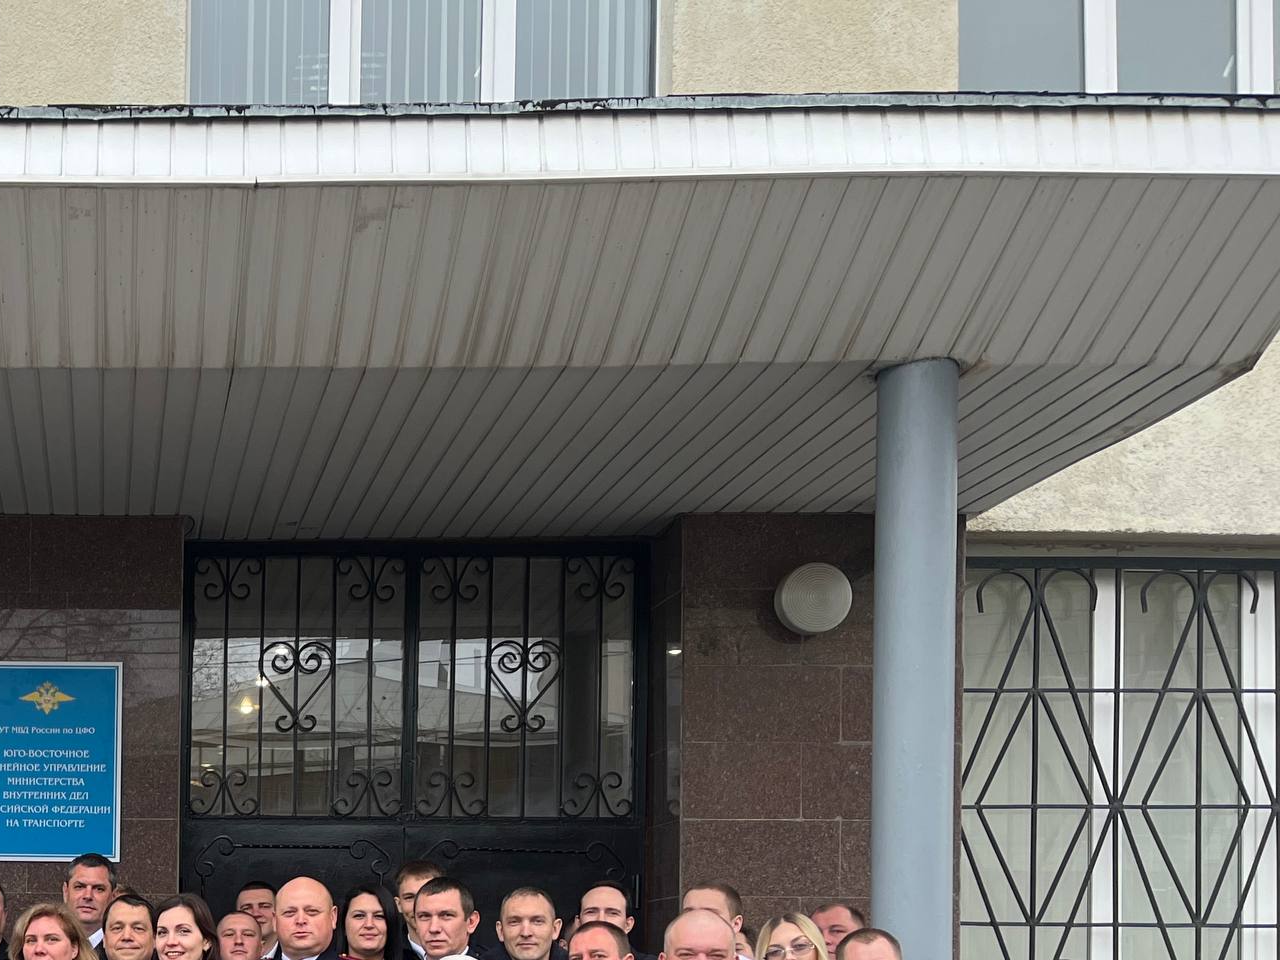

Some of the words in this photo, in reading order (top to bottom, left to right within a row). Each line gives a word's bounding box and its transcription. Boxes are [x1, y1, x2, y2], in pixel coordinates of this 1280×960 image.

[0, 726, 9, 734] УТ
[11, 726, 29, 735] МВД
[31, 726, 60, 734] России
[75, 727, 96, 735] ЦФО
[3, 749, 90, 758] ЮГО-ВОСТОЧНОЕ
[43, 763, 106, 772] УПРАВЛЕНИЕ
[7, 777, 85, 786] МИНИСТЕРСТВА
[2, 791, 67, 800] ВНУТРЕННИХ
[69, 791, 89, 800] ДЕЛ
[51, 805, 111, 814] ФЕДЕРАЦИИ
[6, 819, 19, 827] НА
[23, 819, 85, 828] ТРАНСПОРТЕ
